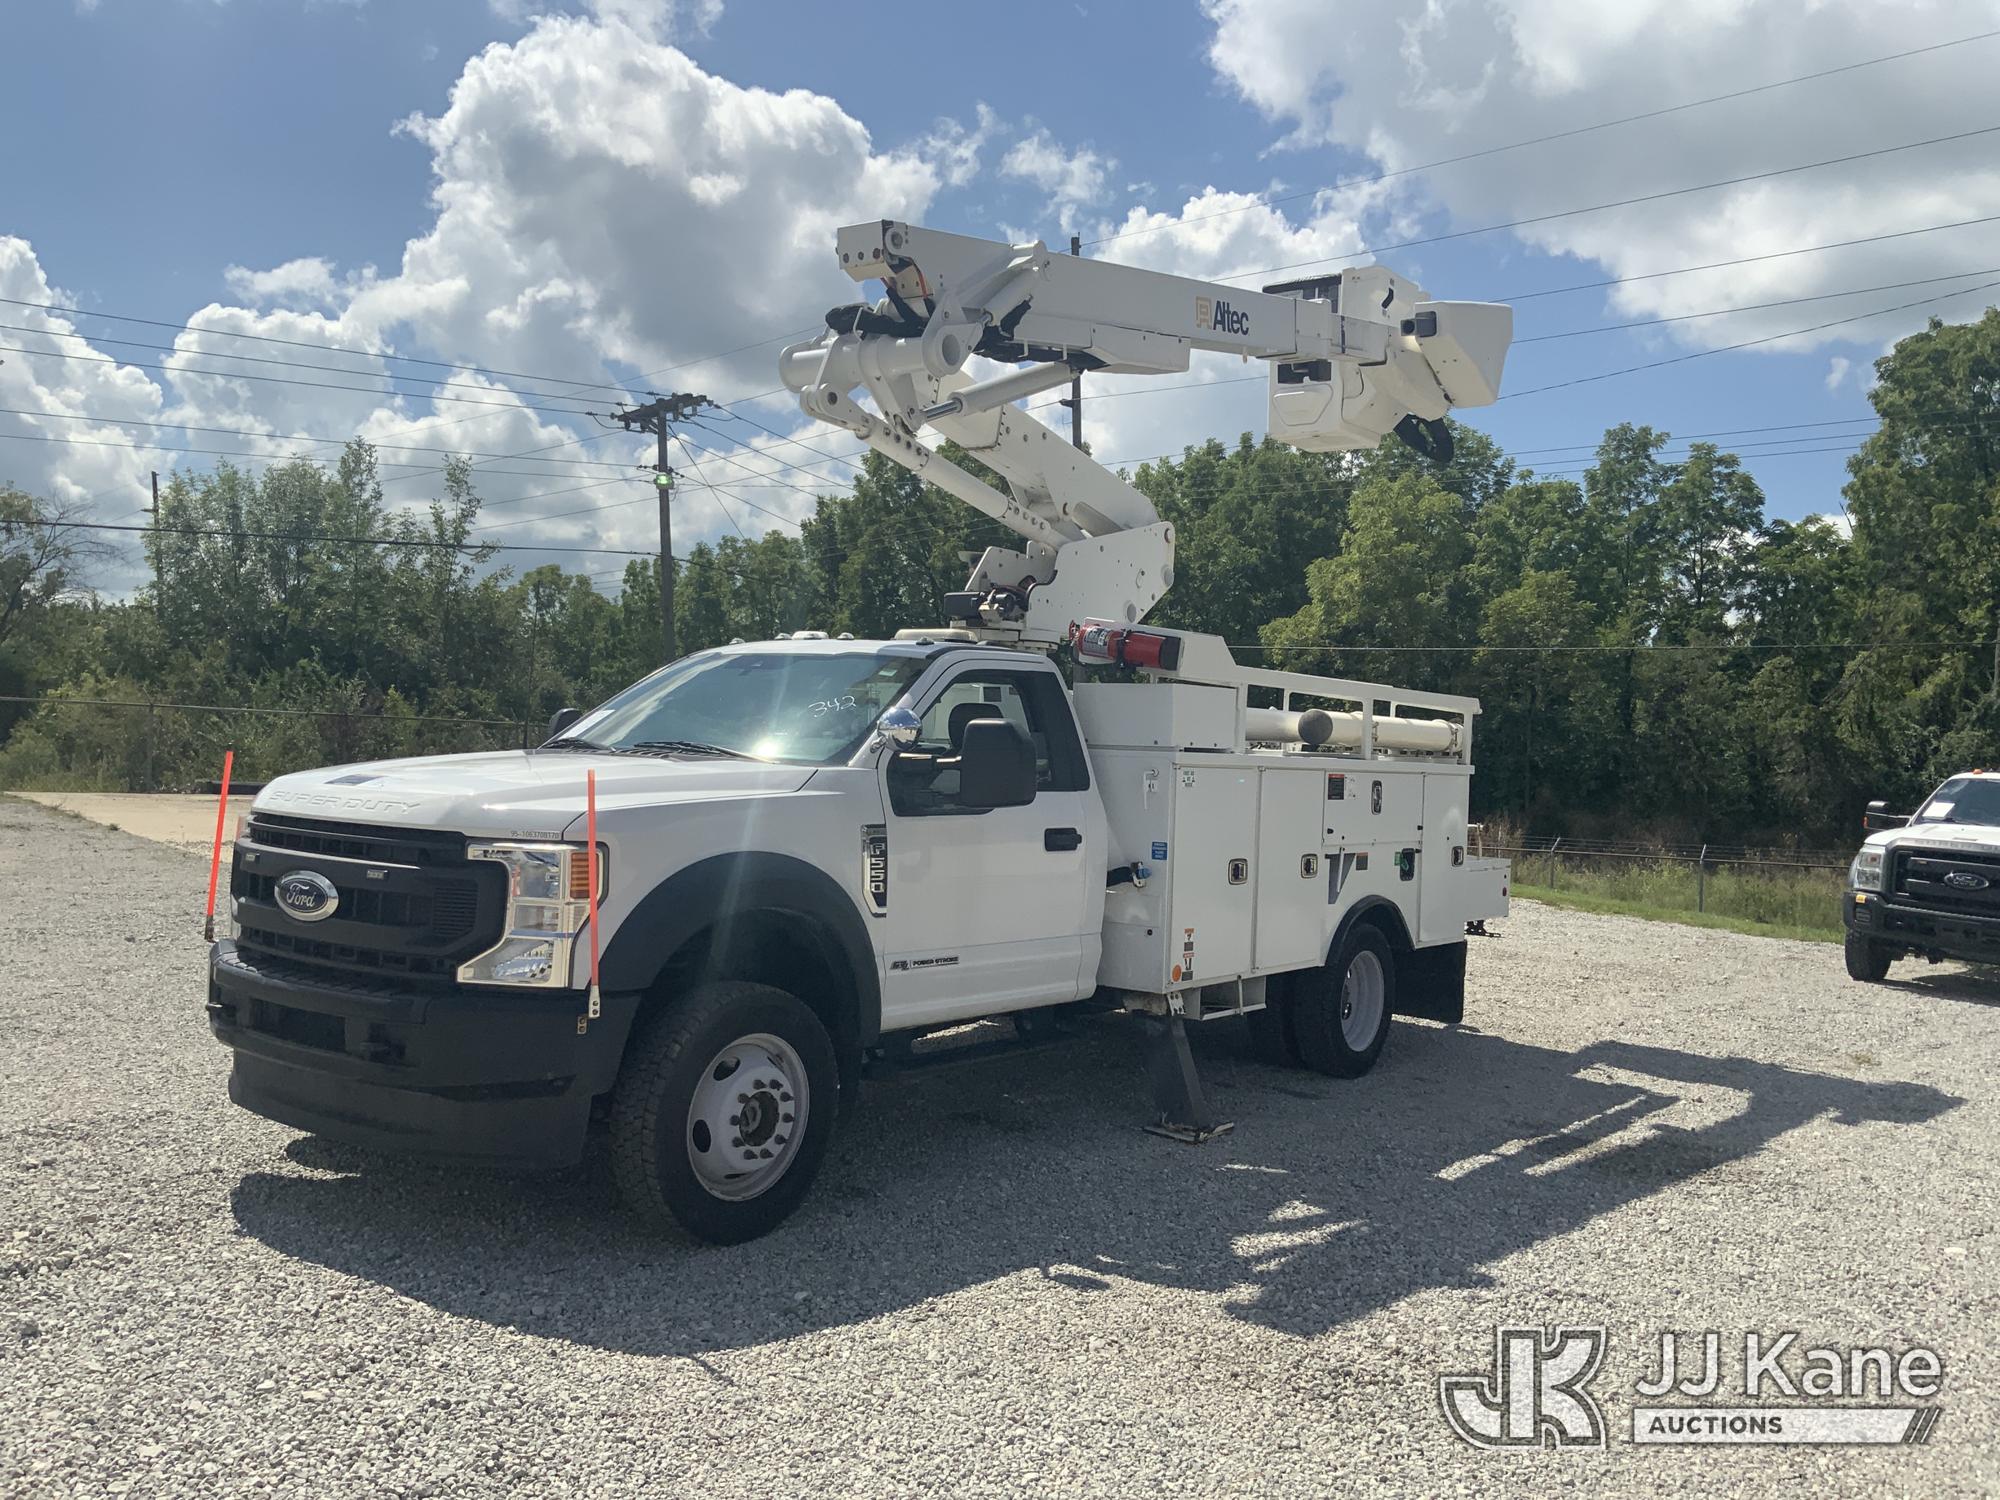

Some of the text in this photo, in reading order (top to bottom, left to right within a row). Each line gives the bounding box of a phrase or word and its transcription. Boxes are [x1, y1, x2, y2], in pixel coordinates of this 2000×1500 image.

[1213, 300, 1249, 336] Altec
[807, 695, 857, 718] 342
[270, 790, 421, 814] SUPER DUTY
[286, 882, 317, 908] Ford
